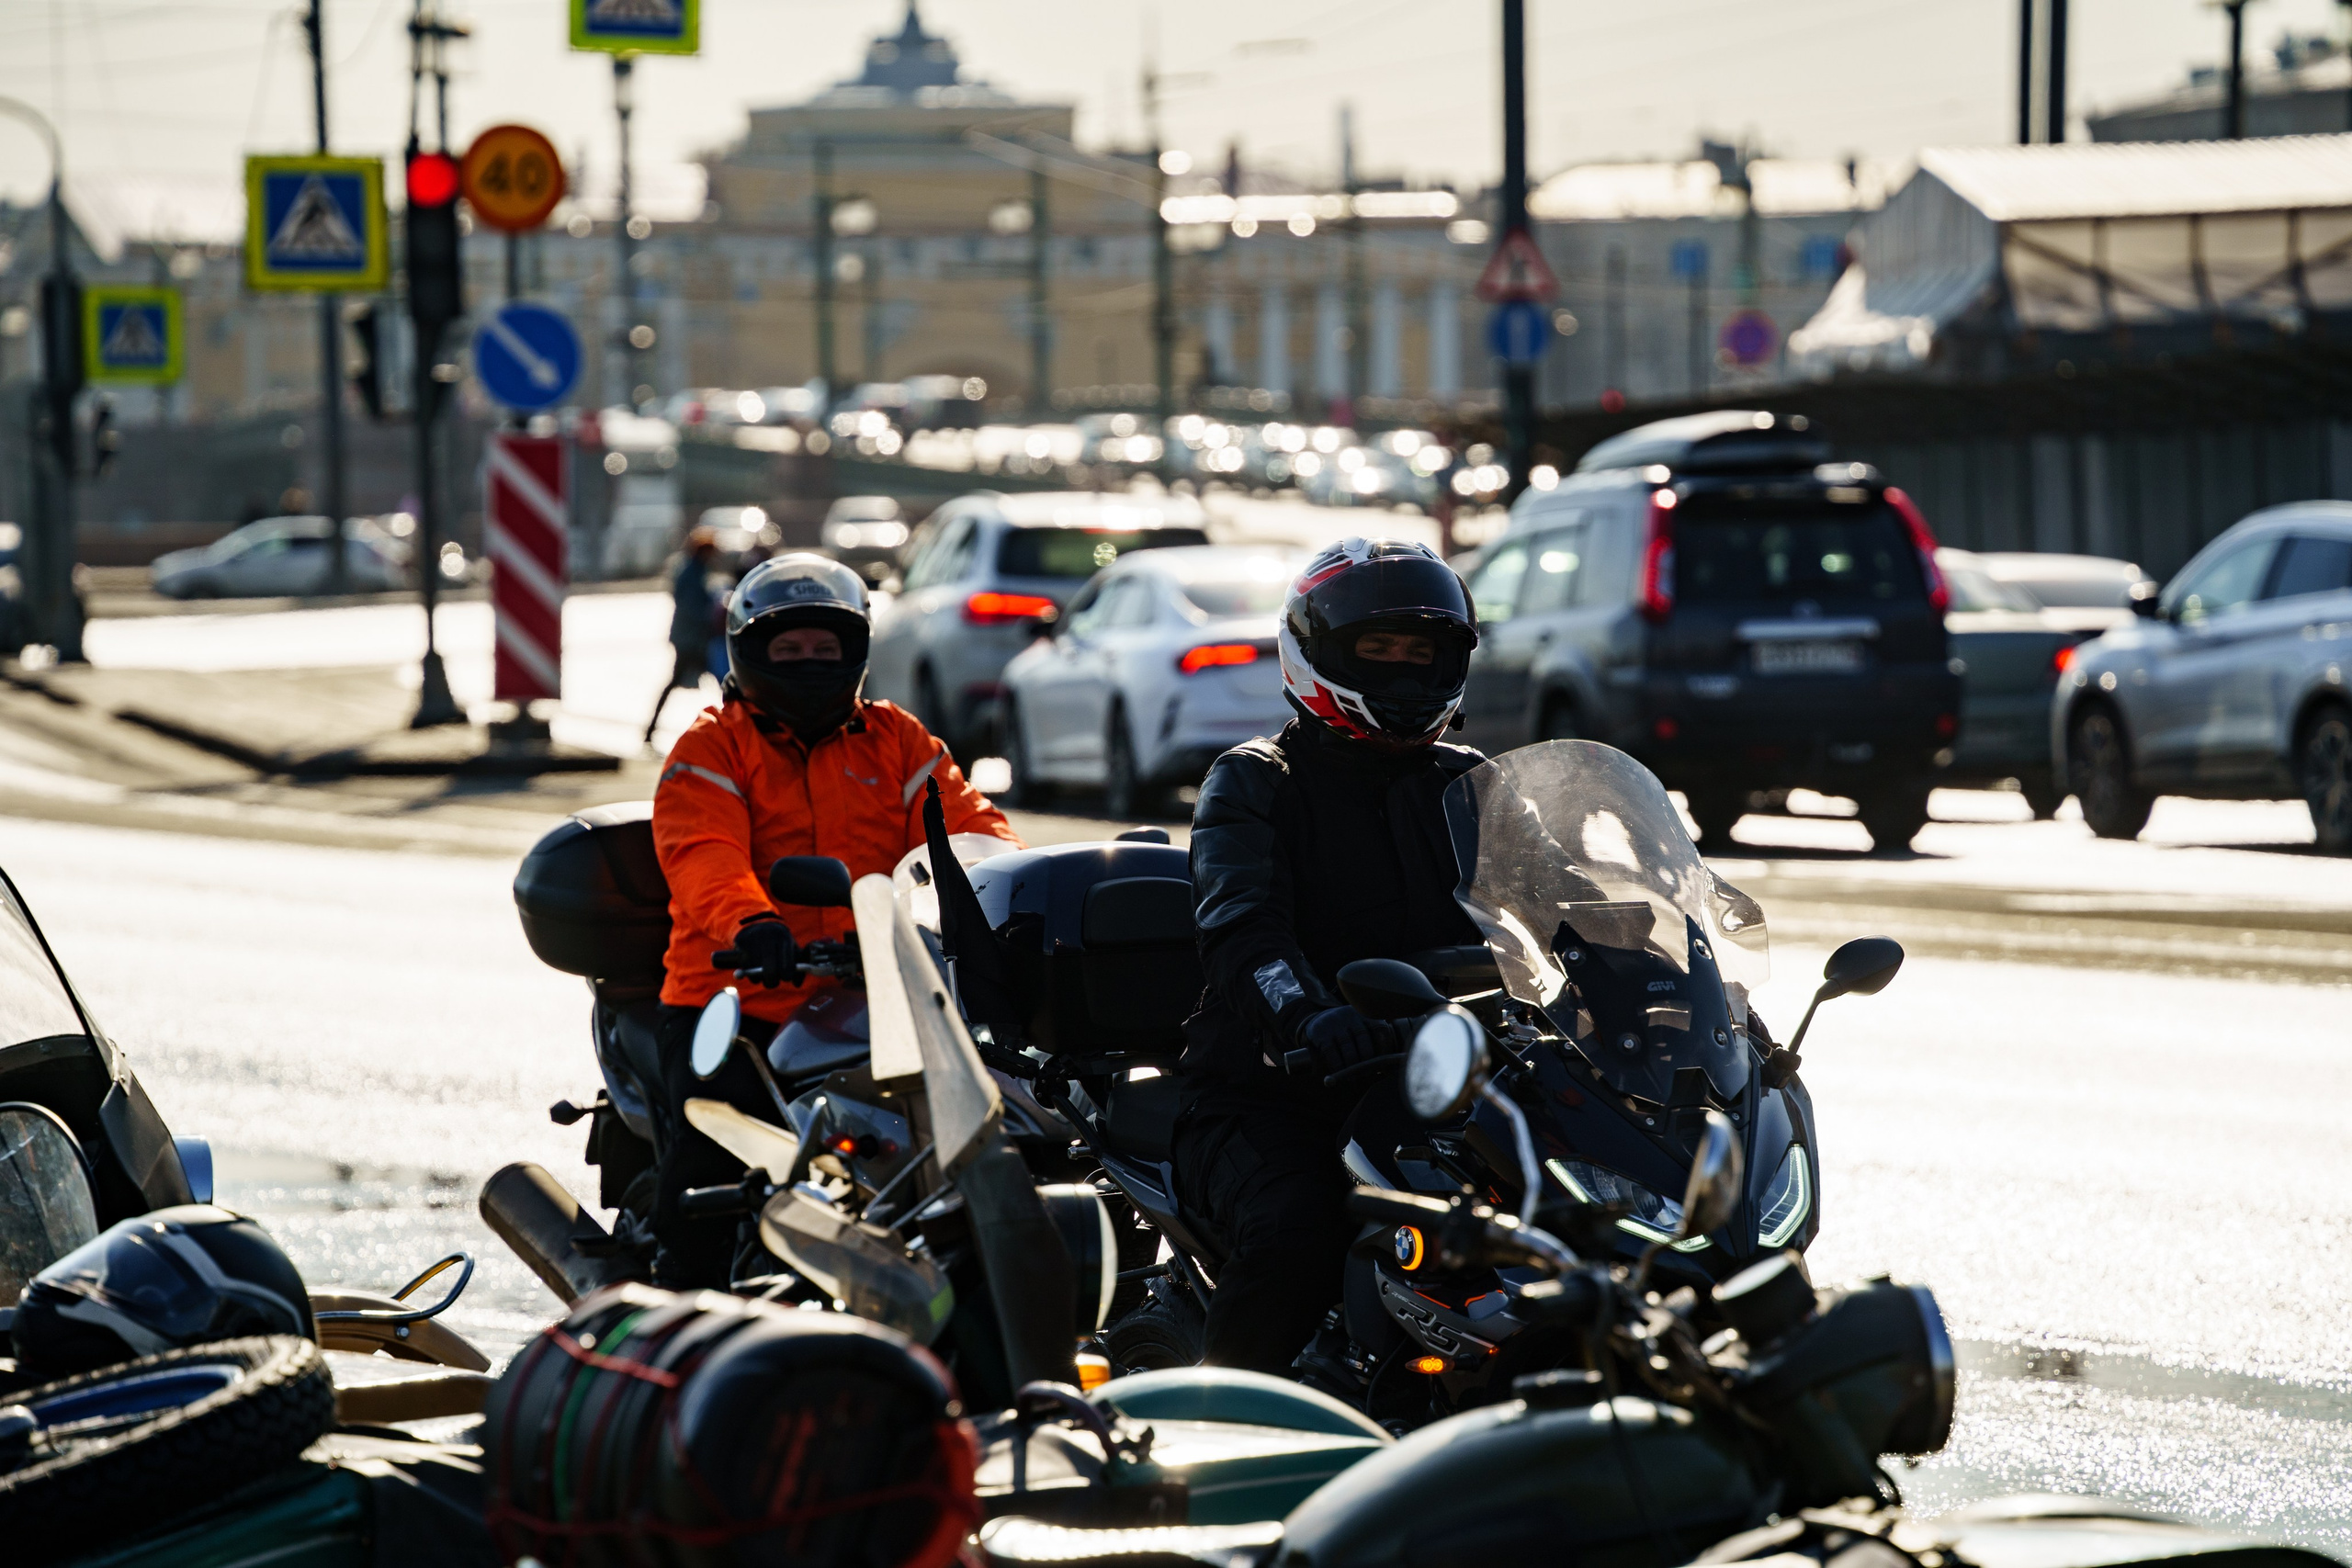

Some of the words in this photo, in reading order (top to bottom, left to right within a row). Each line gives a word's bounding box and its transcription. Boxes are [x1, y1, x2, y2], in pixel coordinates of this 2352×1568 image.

[479, 152, 549, 199] 40
[794, 582, 832, 596] SHO
[1647, 981, 1676, 991] GIVI
[1396, 1302, 1461, 1355] RS
